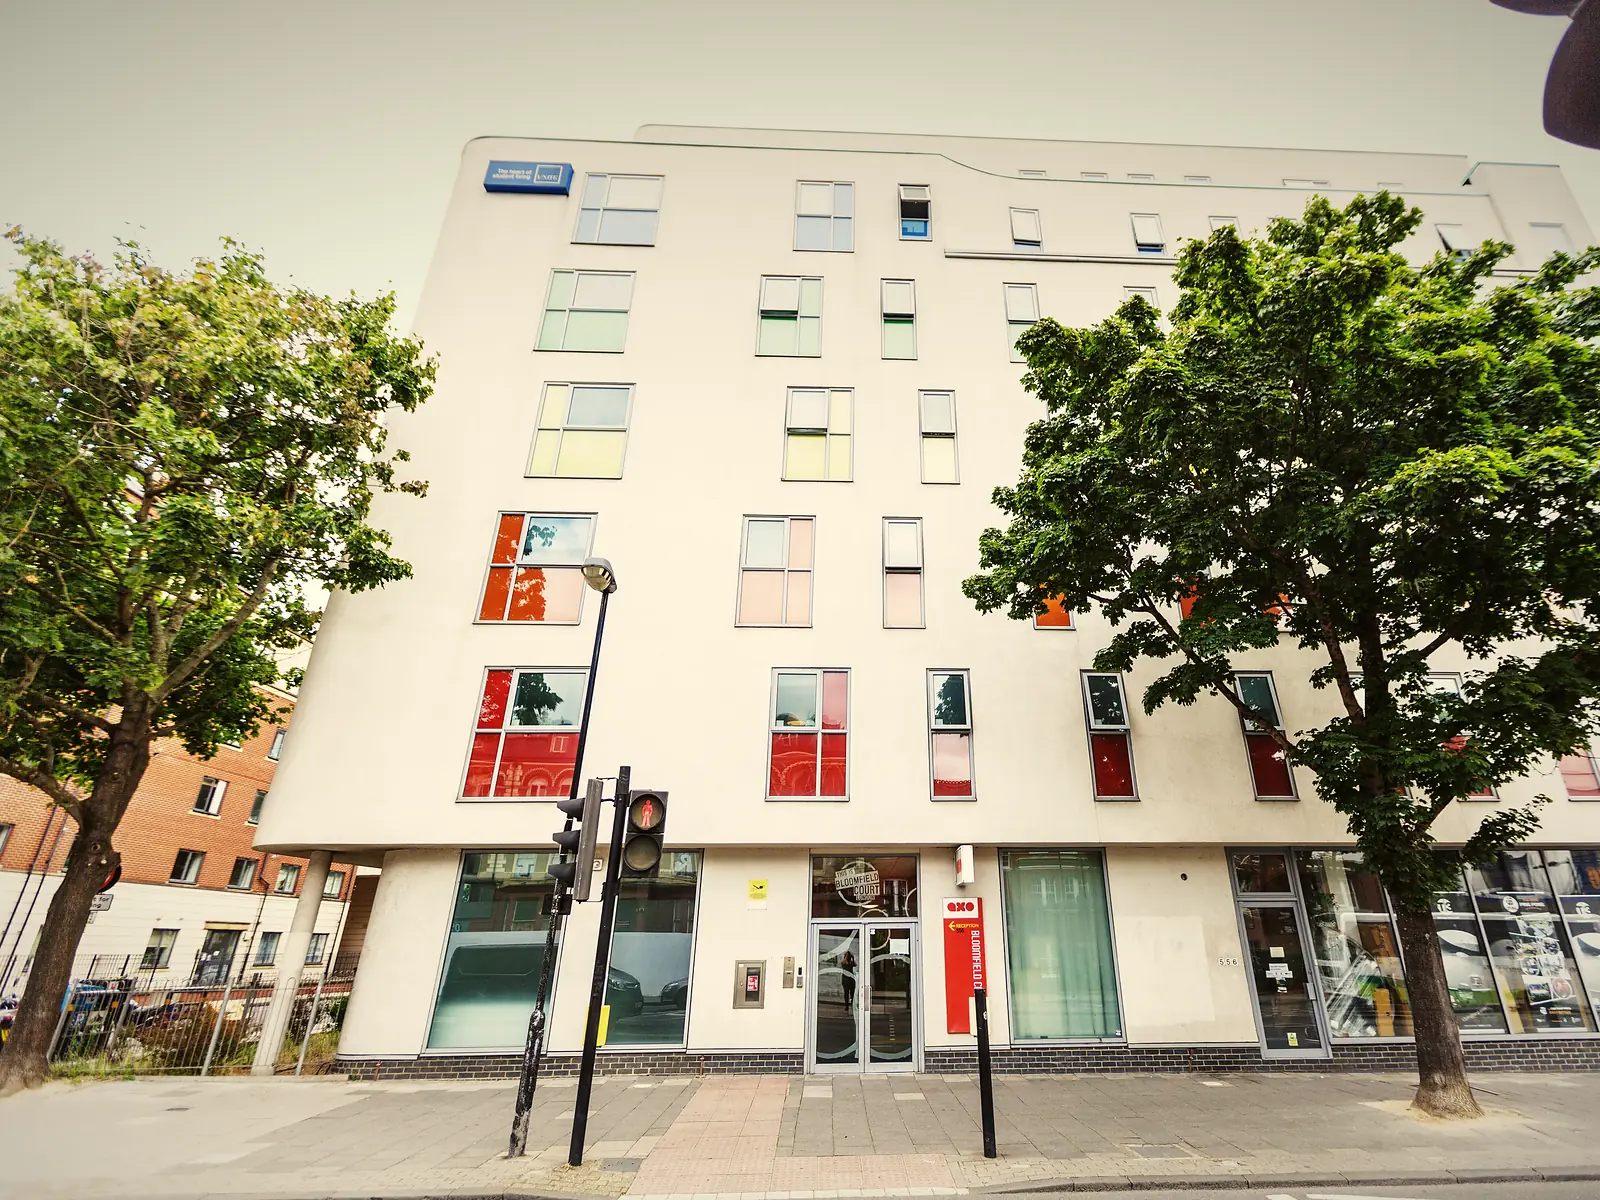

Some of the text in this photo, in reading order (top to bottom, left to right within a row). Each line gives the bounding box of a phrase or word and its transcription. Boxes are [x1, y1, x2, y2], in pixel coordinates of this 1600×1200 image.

[836, 868, 854, 878] THIS IS
[836, 872, 879, 889] BLOOMFIELD
[854, 885, 880, 895] COURT
[971, 930, 983, 980] BLOOMFIELD
[1219, 958, 1238, 966] 556
